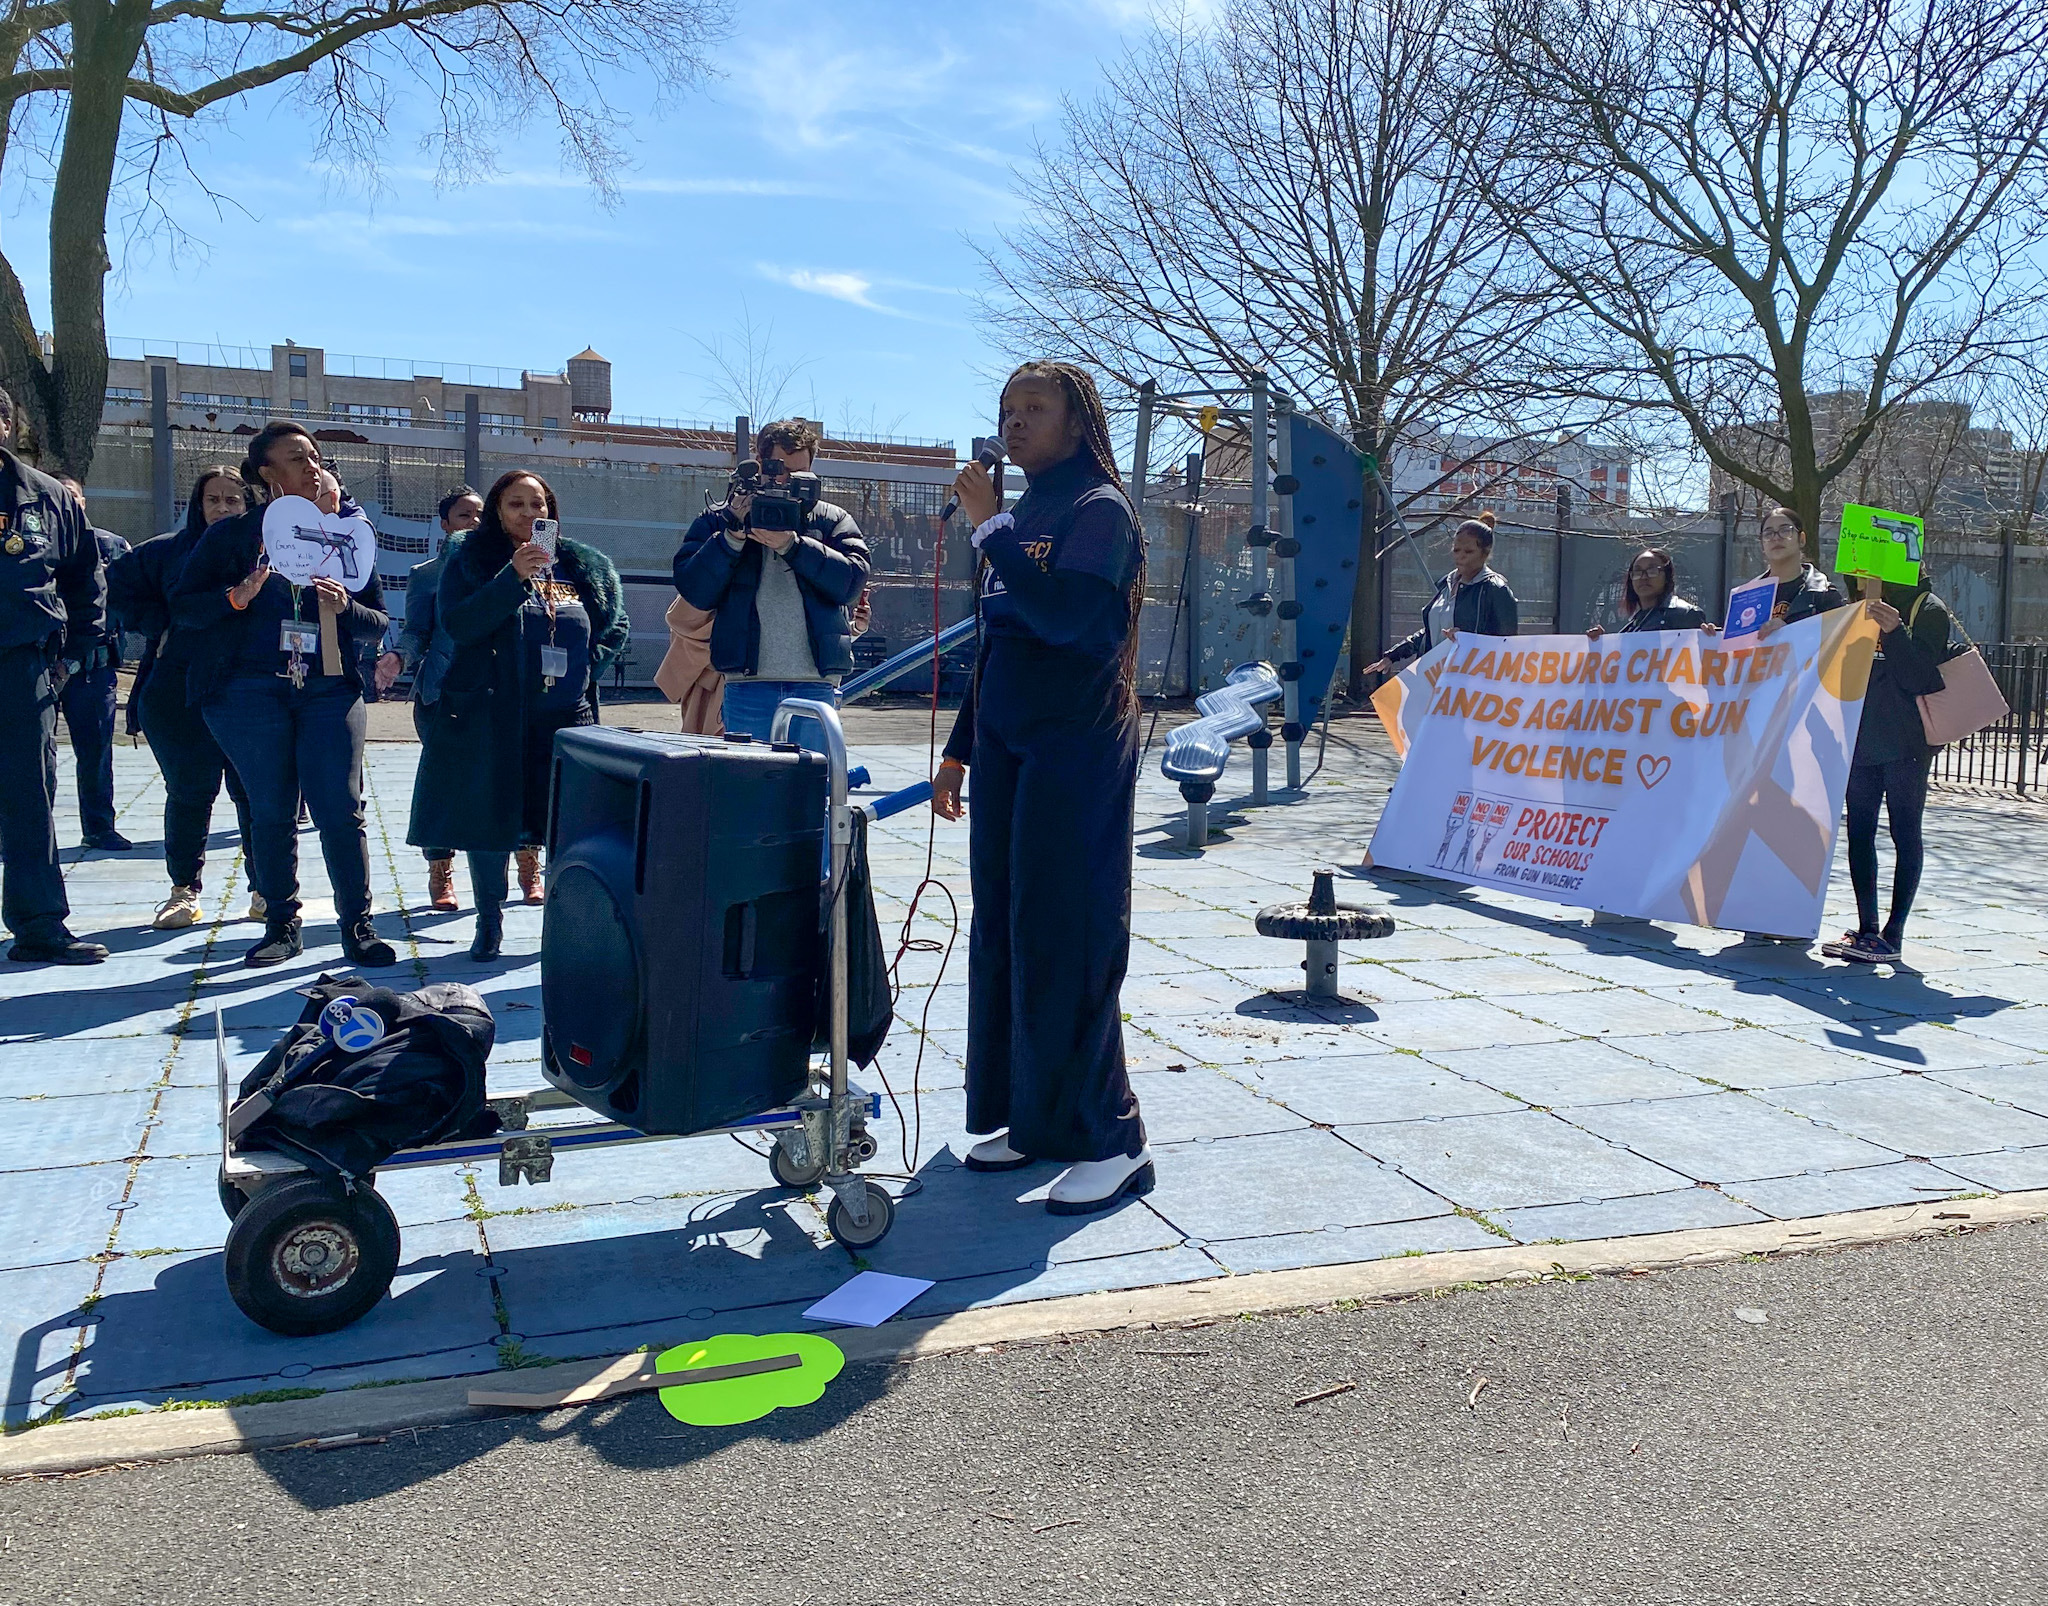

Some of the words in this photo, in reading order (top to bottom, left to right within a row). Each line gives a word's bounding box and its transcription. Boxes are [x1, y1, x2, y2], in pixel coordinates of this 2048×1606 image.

[276, 540, 296, 550] Guns
[1626, 643, 1790, 686] CHARTER
[1522, 698, 1662, 734] AGAINST
[1670, 699, 1750, 738] GUN
[1471, 735, 1627, 785] VIOLENCE
[1456, 795, 1470, 806] NO
[1476, 802, 1491, 814] NO
[1494, 804, 1509, 816] NO
[1512, 807, 1609, 848] PROTECT
[1503, 840, 1531, 862] OUR
[1531, 844, 1594, 871] SCHOOLS
[1493, 863, 1520, 879] FROM
[1520, 867, 1541, 883] GUN
[1541, 871, 1584, 890] VIOLENCE
[329, 1004, 350, 1024] abc
